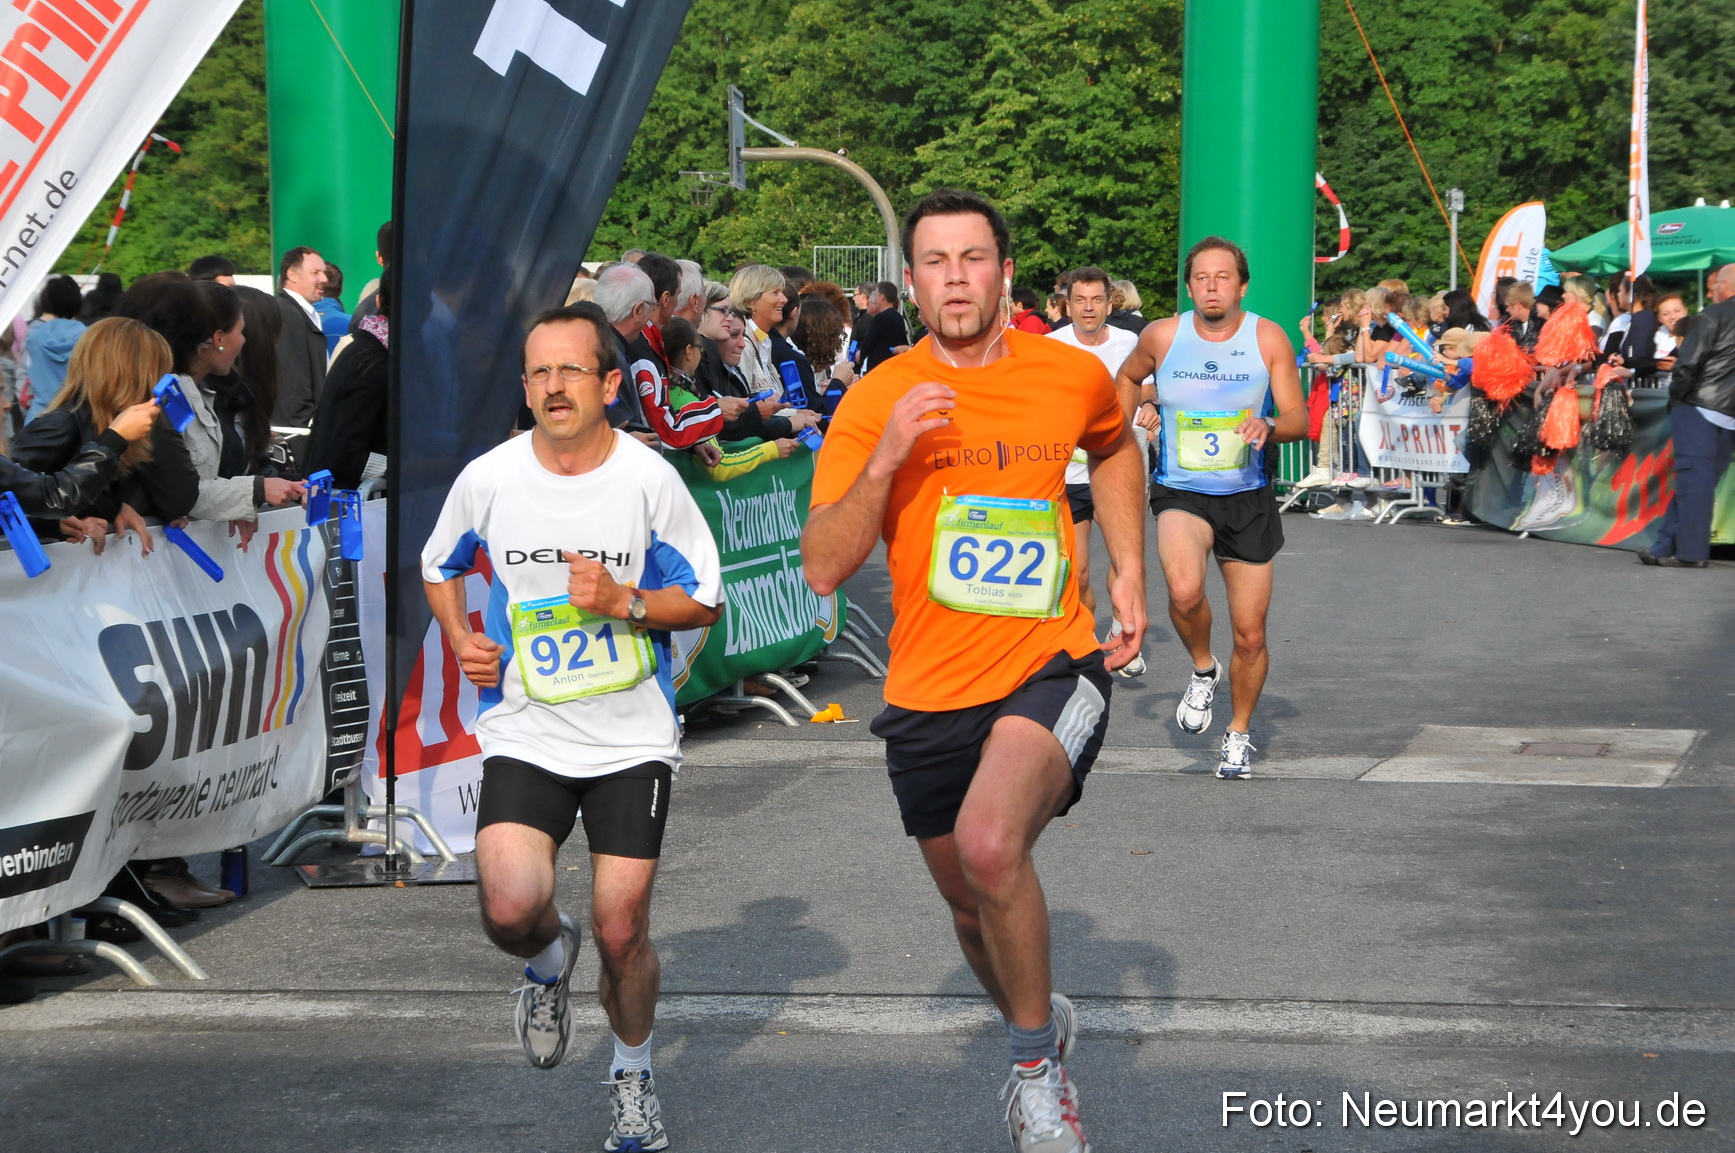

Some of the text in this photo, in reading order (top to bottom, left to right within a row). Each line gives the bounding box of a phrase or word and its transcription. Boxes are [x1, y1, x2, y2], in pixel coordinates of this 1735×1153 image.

[0, 168, 79, 290] -net.de
[1172, 370, 1250, 382] SCHABMÜLLER
[933, 442, 1071, 470] EURO POLES
[1203, 432, 1220, 457] 3
[715, 474, 802, 554] Neumarkter
[957, 517, 1005, 531] firmenlauf
[505, 548, 631, 567] DELPHI
[948, 535, 1046, 587] 622
[724, 545, 820, 657] Lammsbr
[966, 583, 1005, 598] Tobias
[529, 614, 570, 630] firmenlauf
[530, 622, 620, 678] 921
[552, 672, 585, 687] Anton
